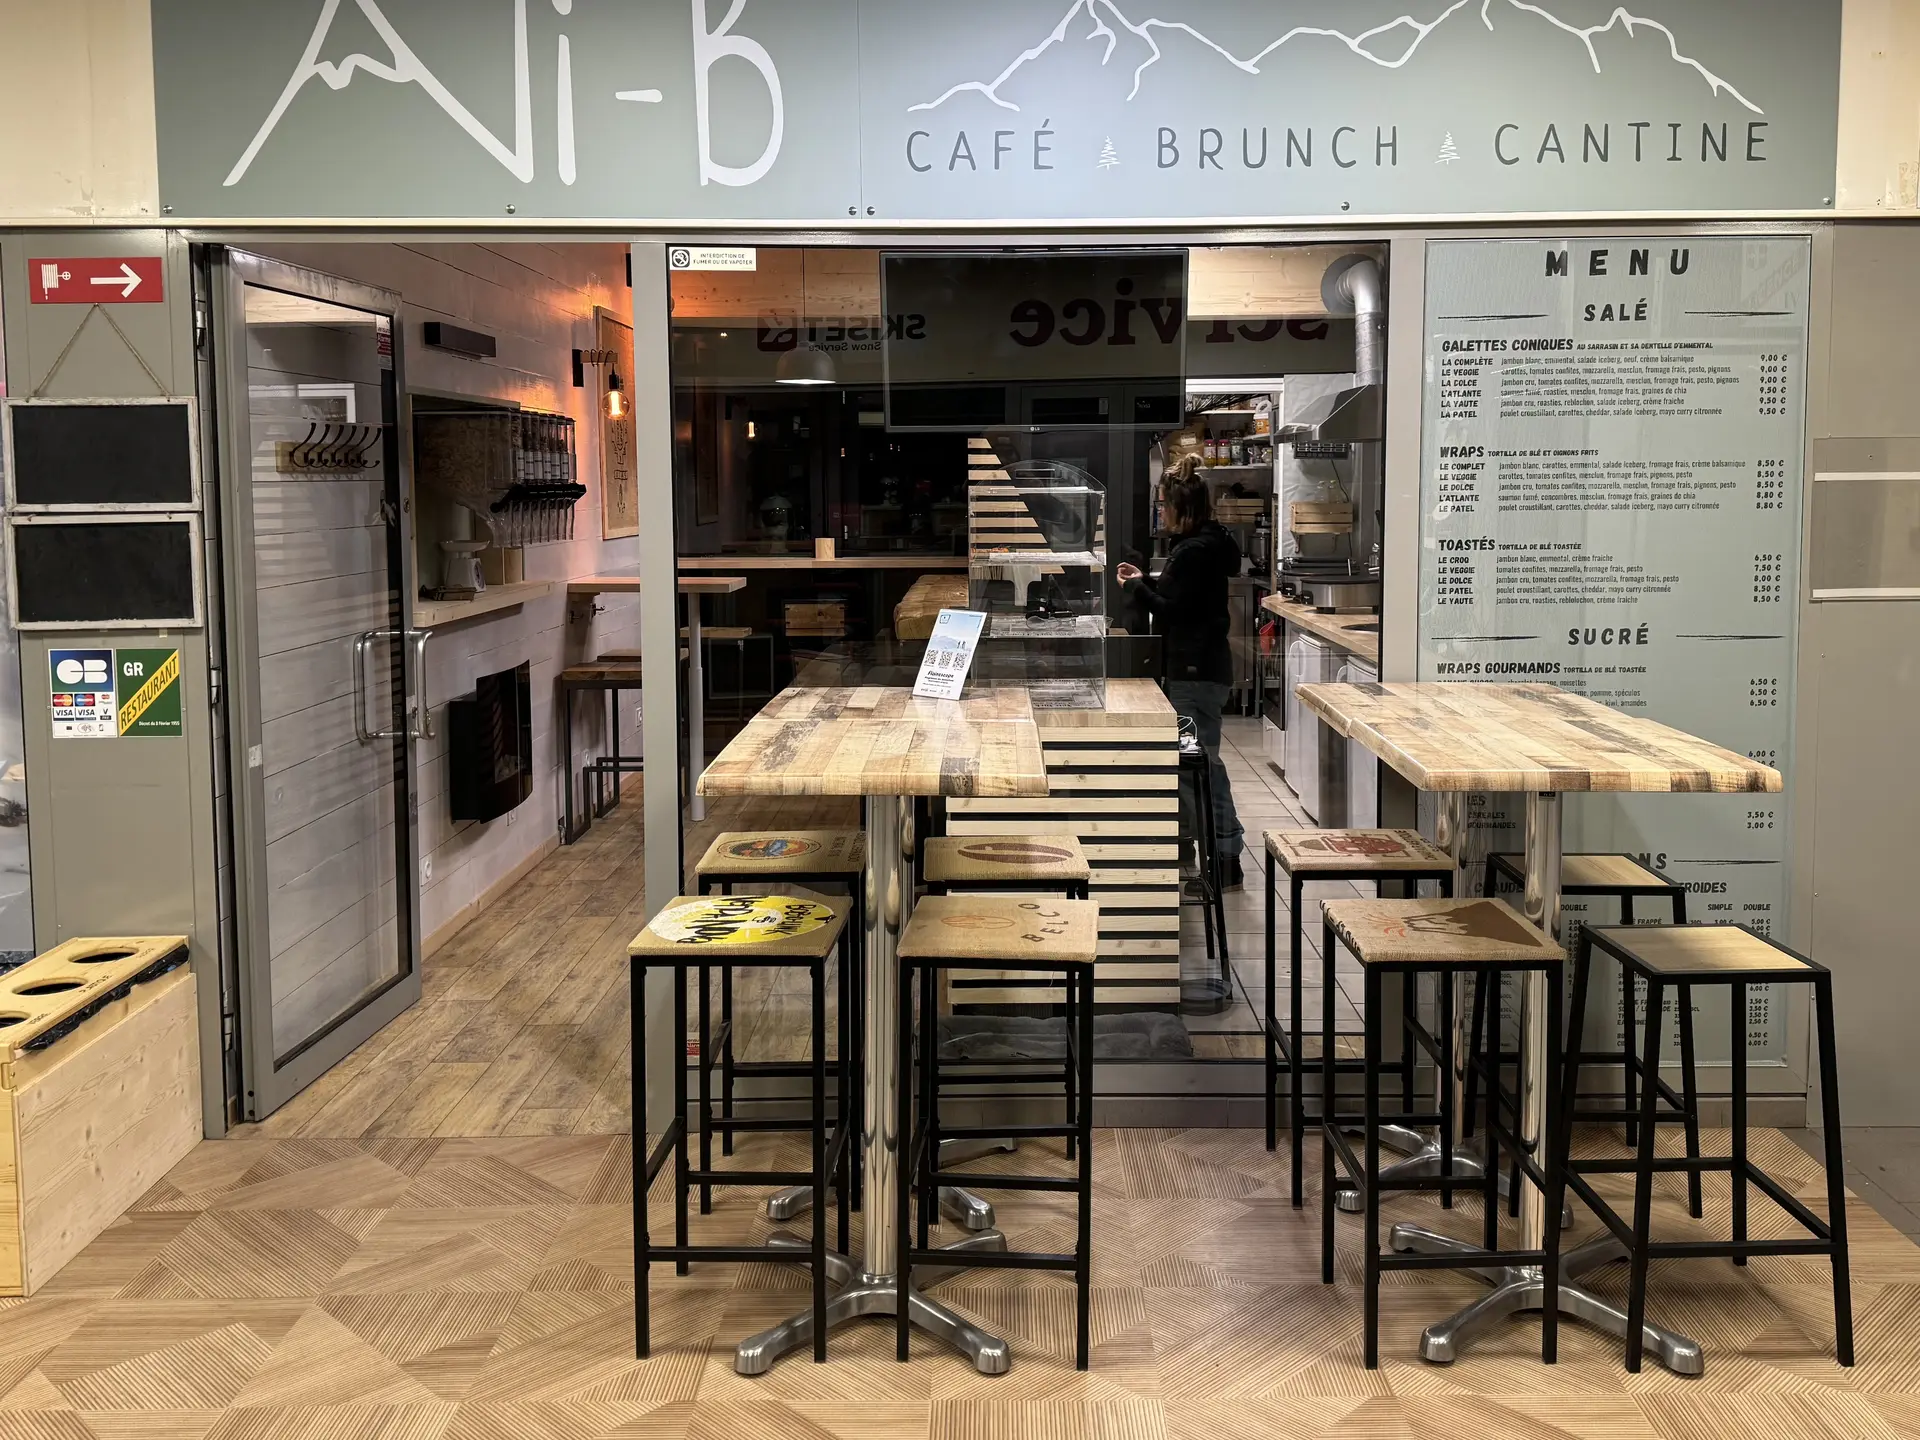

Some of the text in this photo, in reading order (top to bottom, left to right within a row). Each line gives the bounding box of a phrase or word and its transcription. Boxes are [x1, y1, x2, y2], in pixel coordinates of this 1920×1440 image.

[906, 119, 1768, 174] CAFÉ BRUNCH CANTINE
[1545, 249, 1689, 276] MENU
[1584, 298, 1647, 321] SALÉ
[1442, 340, 1507, 352] GALETTES
[1512, 339, 1573, 351] CONIQUES
[1454, 357, 1493, 365] COMPLÈTE
[1440, 446, 1484, 457] WRAPS
[1499, 462, 1521, 470] jambon
[1623, 461, 1647, 469] iceberg,
[1439, 536, 1495, 551] TOASTÉS
[1549, 565, 1582, 573] mozzarella,
[1584, 565, 1608, 573] fromage
[1610, 565, 1625, 573] frais,
[1568, 623, 1648, 645] SUCRÉ
[56, 659, 107, 684] CB
[124, 662, 143, 676] GR
[1437, 663, 1480, 674] WRAPS
[1485, 662, 1560, 674] GOURMANDS
[1559, 680, 1586, 688] noisettes
[121, 656, 177, 730] RESTAURANT
[1620, 700, 1647, 708] amandes
[1018, 903, 1068, 942] BELCO
